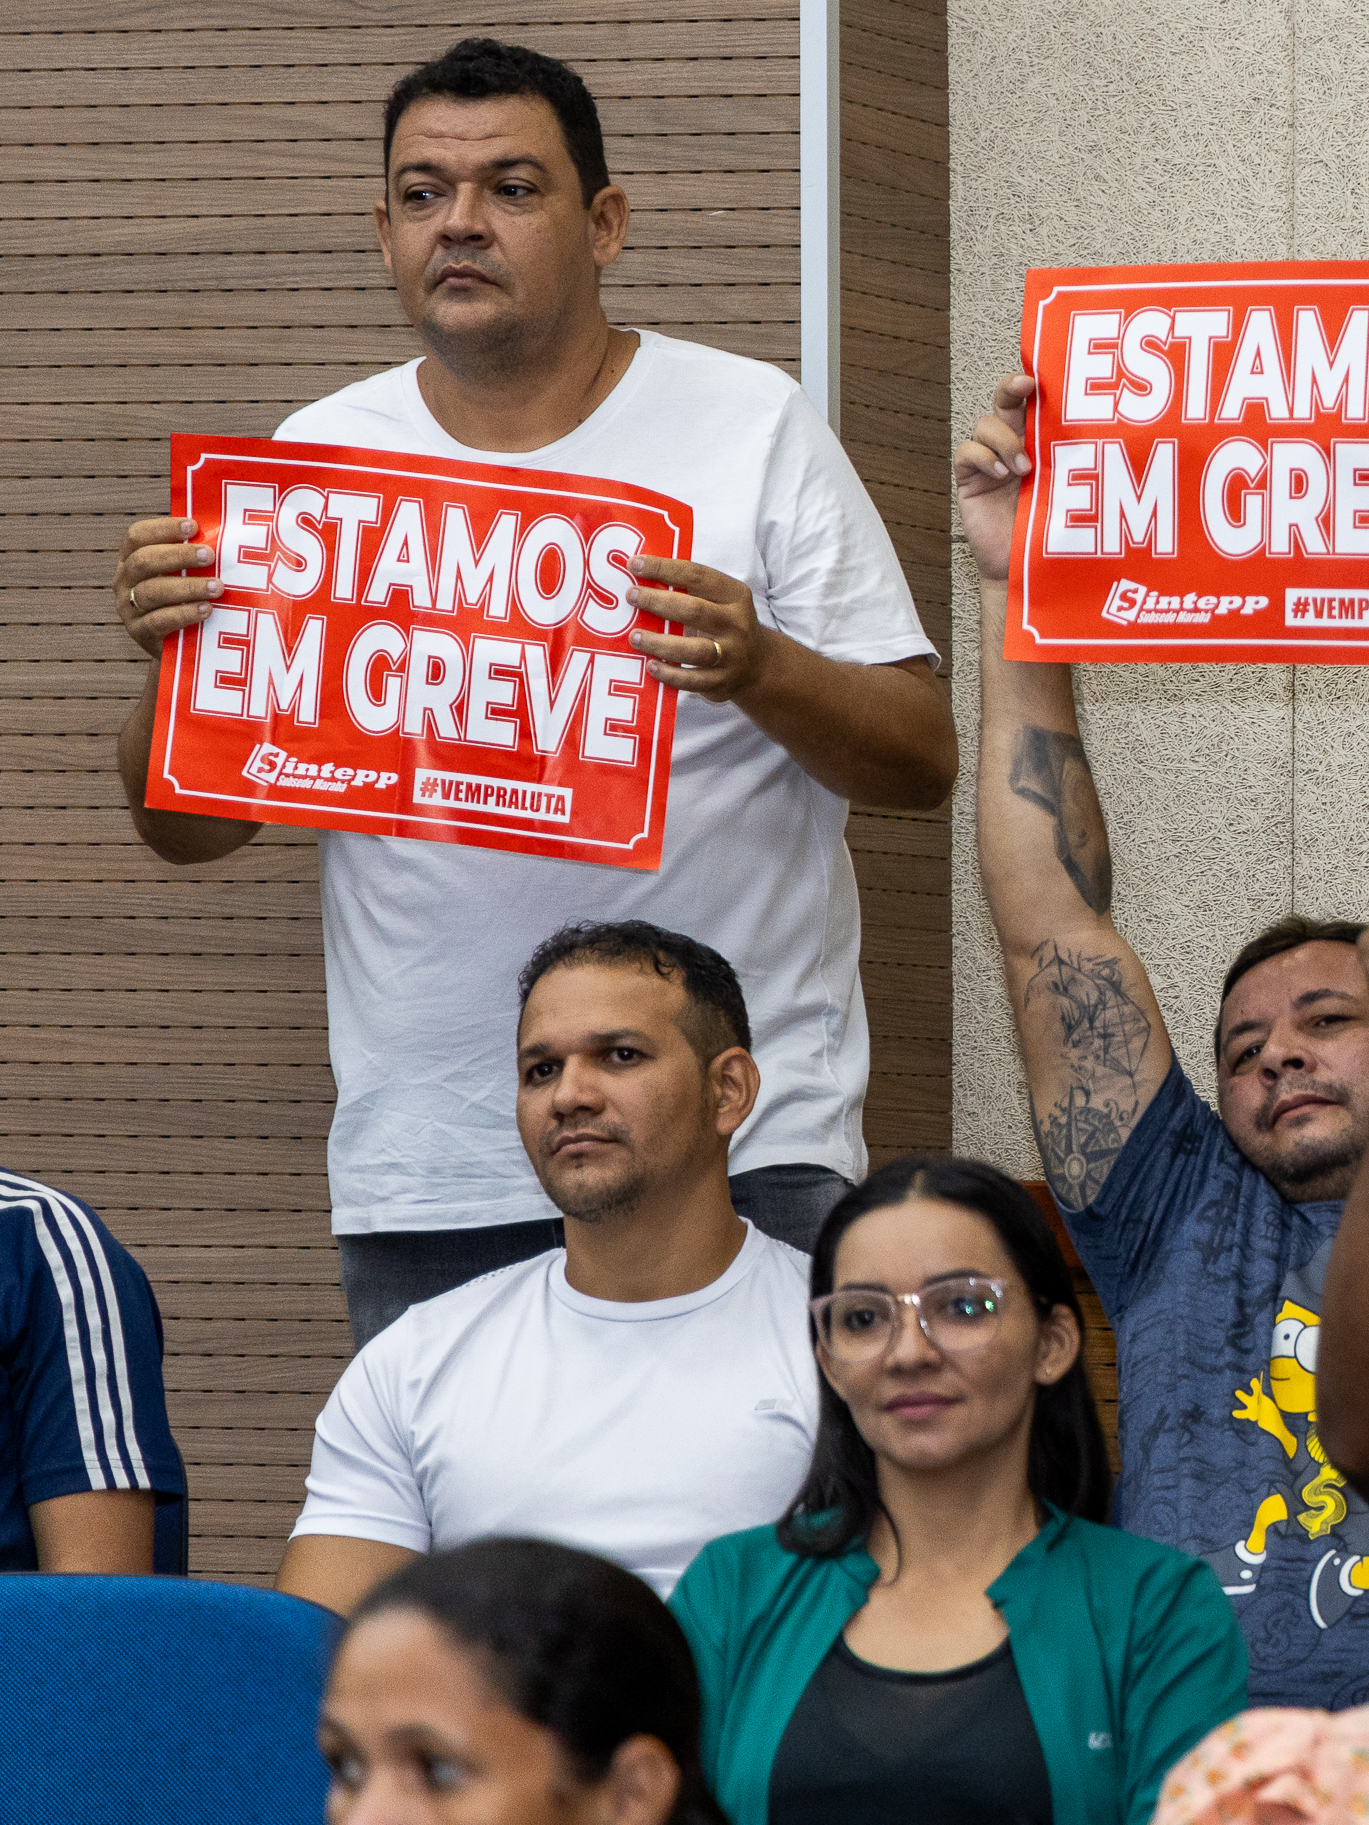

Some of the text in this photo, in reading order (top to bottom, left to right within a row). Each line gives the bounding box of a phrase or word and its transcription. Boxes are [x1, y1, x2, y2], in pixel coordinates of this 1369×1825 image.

[1042, 437, 1177, 559] EM
[216, 480, 646, 638] ESTAMOS
[1115, 586, 1269, 616] Sintepp
[191, 603, 647, 766] EM GREVE
[256, 751, 399, 789] Sintepp
[276, 774, 348, 793] Subsede Marabá
[419, 776, 567, 817] #VEMPRALUTA
